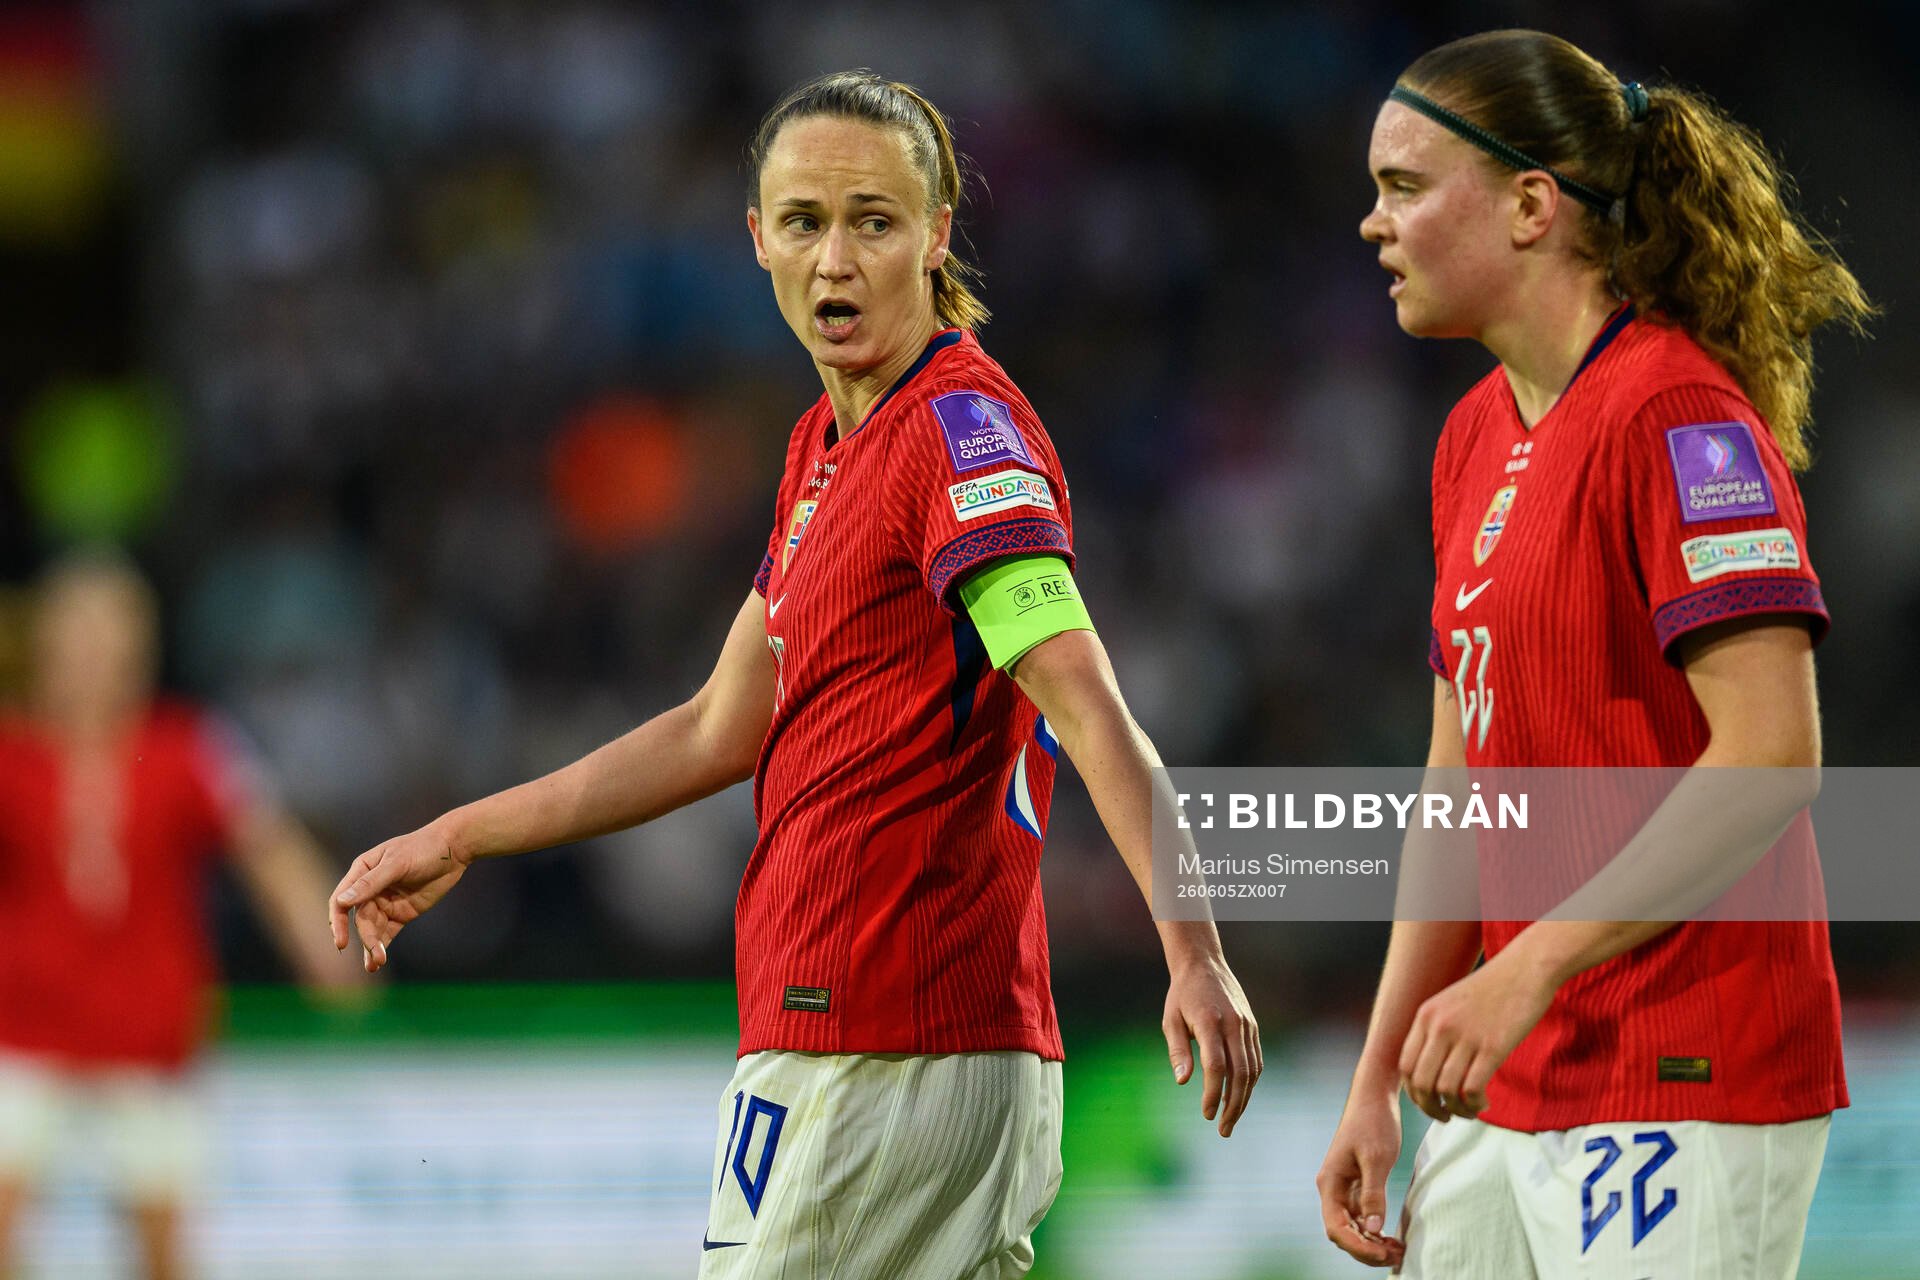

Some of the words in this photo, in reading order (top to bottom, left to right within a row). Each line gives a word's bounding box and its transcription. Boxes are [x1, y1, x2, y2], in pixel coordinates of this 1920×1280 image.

[952, 483, 978, 496] UEFA
[954, 479, 1050, 508] FOUNDATION
[1688, 540, 1796, 566] FOUNDATION
[1451, 626, 1494, 752] 22
[718, 1089, 788, 1220] 10
[1581, 1130, 1678, 1254] 22
